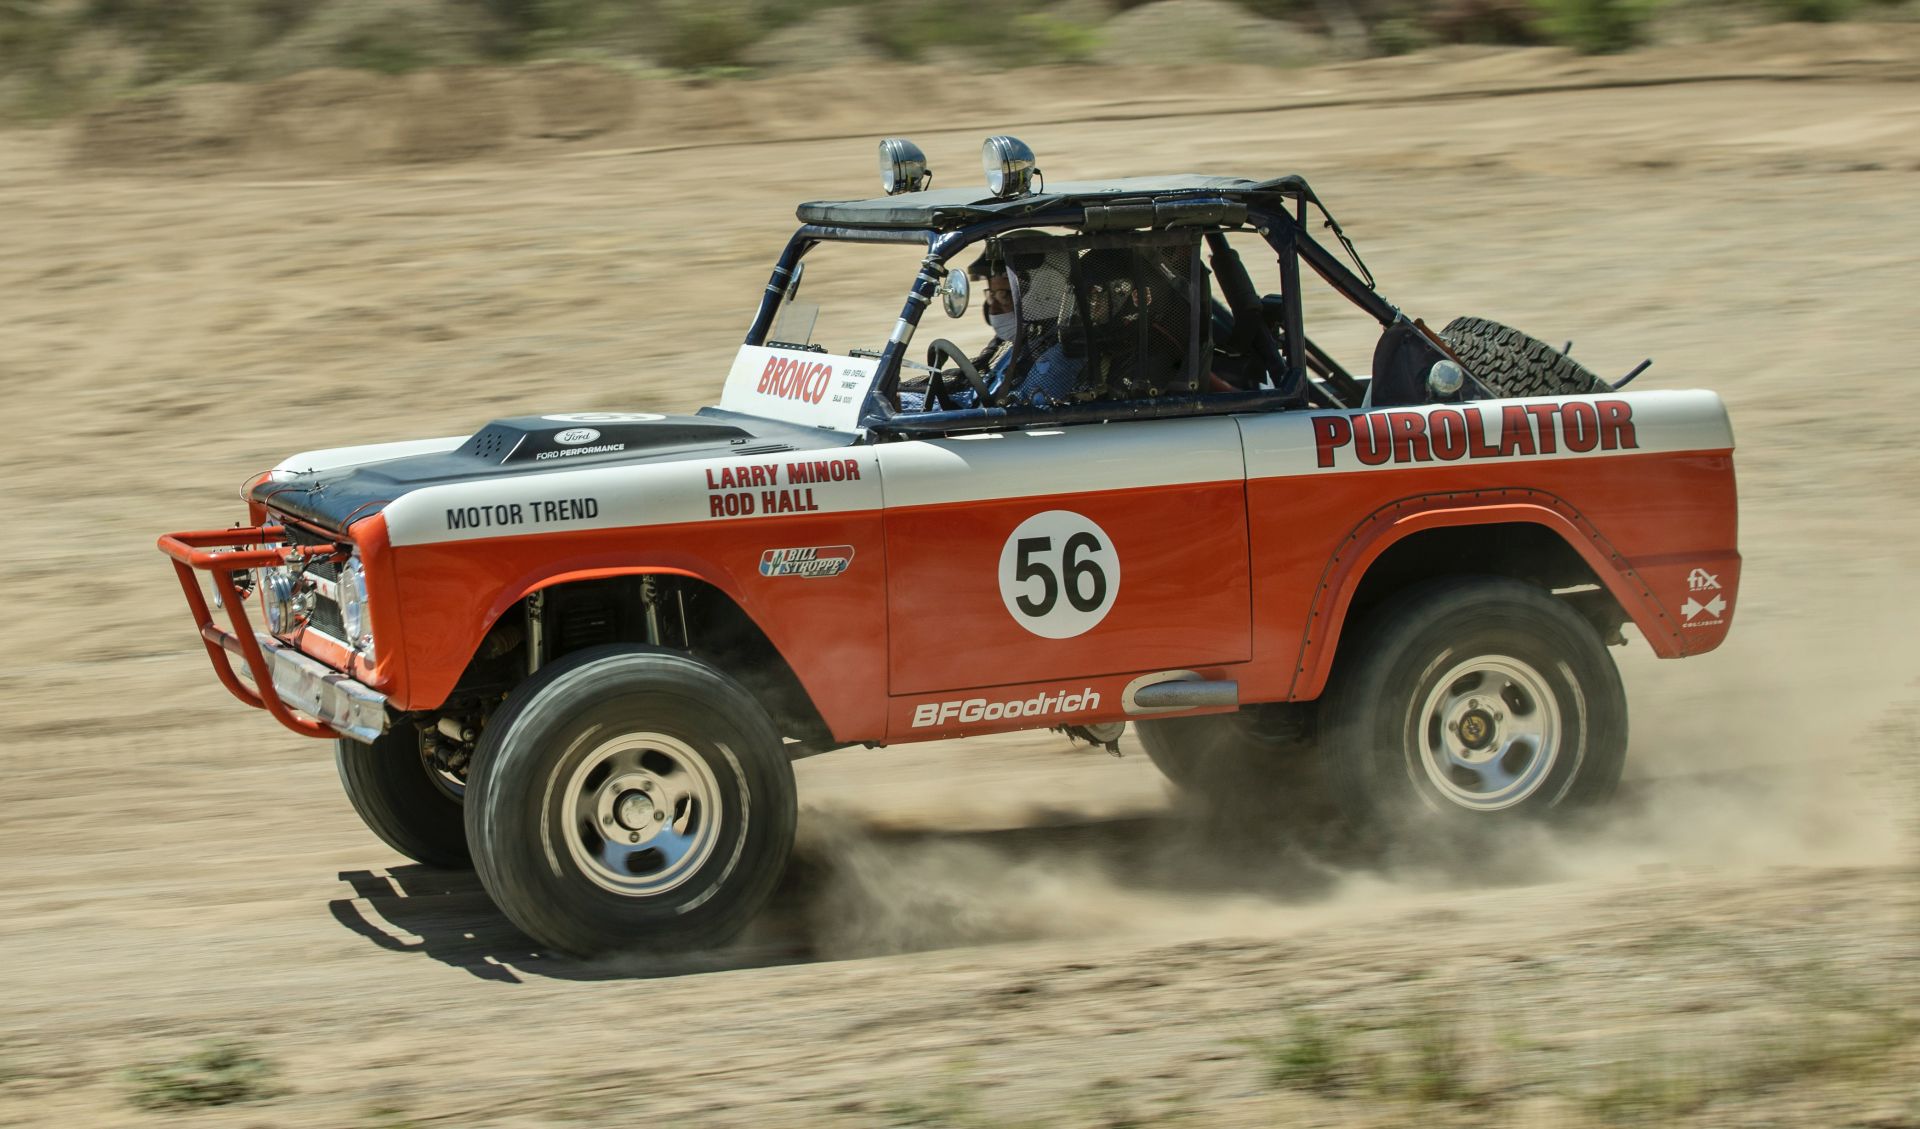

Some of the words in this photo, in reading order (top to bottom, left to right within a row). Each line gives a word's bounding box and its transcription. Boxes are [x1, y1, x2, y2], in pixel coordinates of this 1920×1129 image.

[757, 355, 833, 405] BRONCO
[1311, 399, 1640, 469] PUROLATOR
[536, 449, 559, 460] FORD
[559, 443, 625, 458] PERFORMANCE
[705, 463, 777, 491] LARRY
[787, 458, 861, 485] MINOR
[446, 502, 523, 530] MOTOR
[529, 497, 599, 524] TREND
[709, 492, 755, 518] ROD
[761, 488, 819, 514] HALL
[782, 558, 843, 574] STROPPE
[787, 548, 817, 562] BILL
[1015, 531, 1107, 618] 56
[1686, 568, 1722, 589] fix
[911, 687, 1101, 728] BFGoodrich
